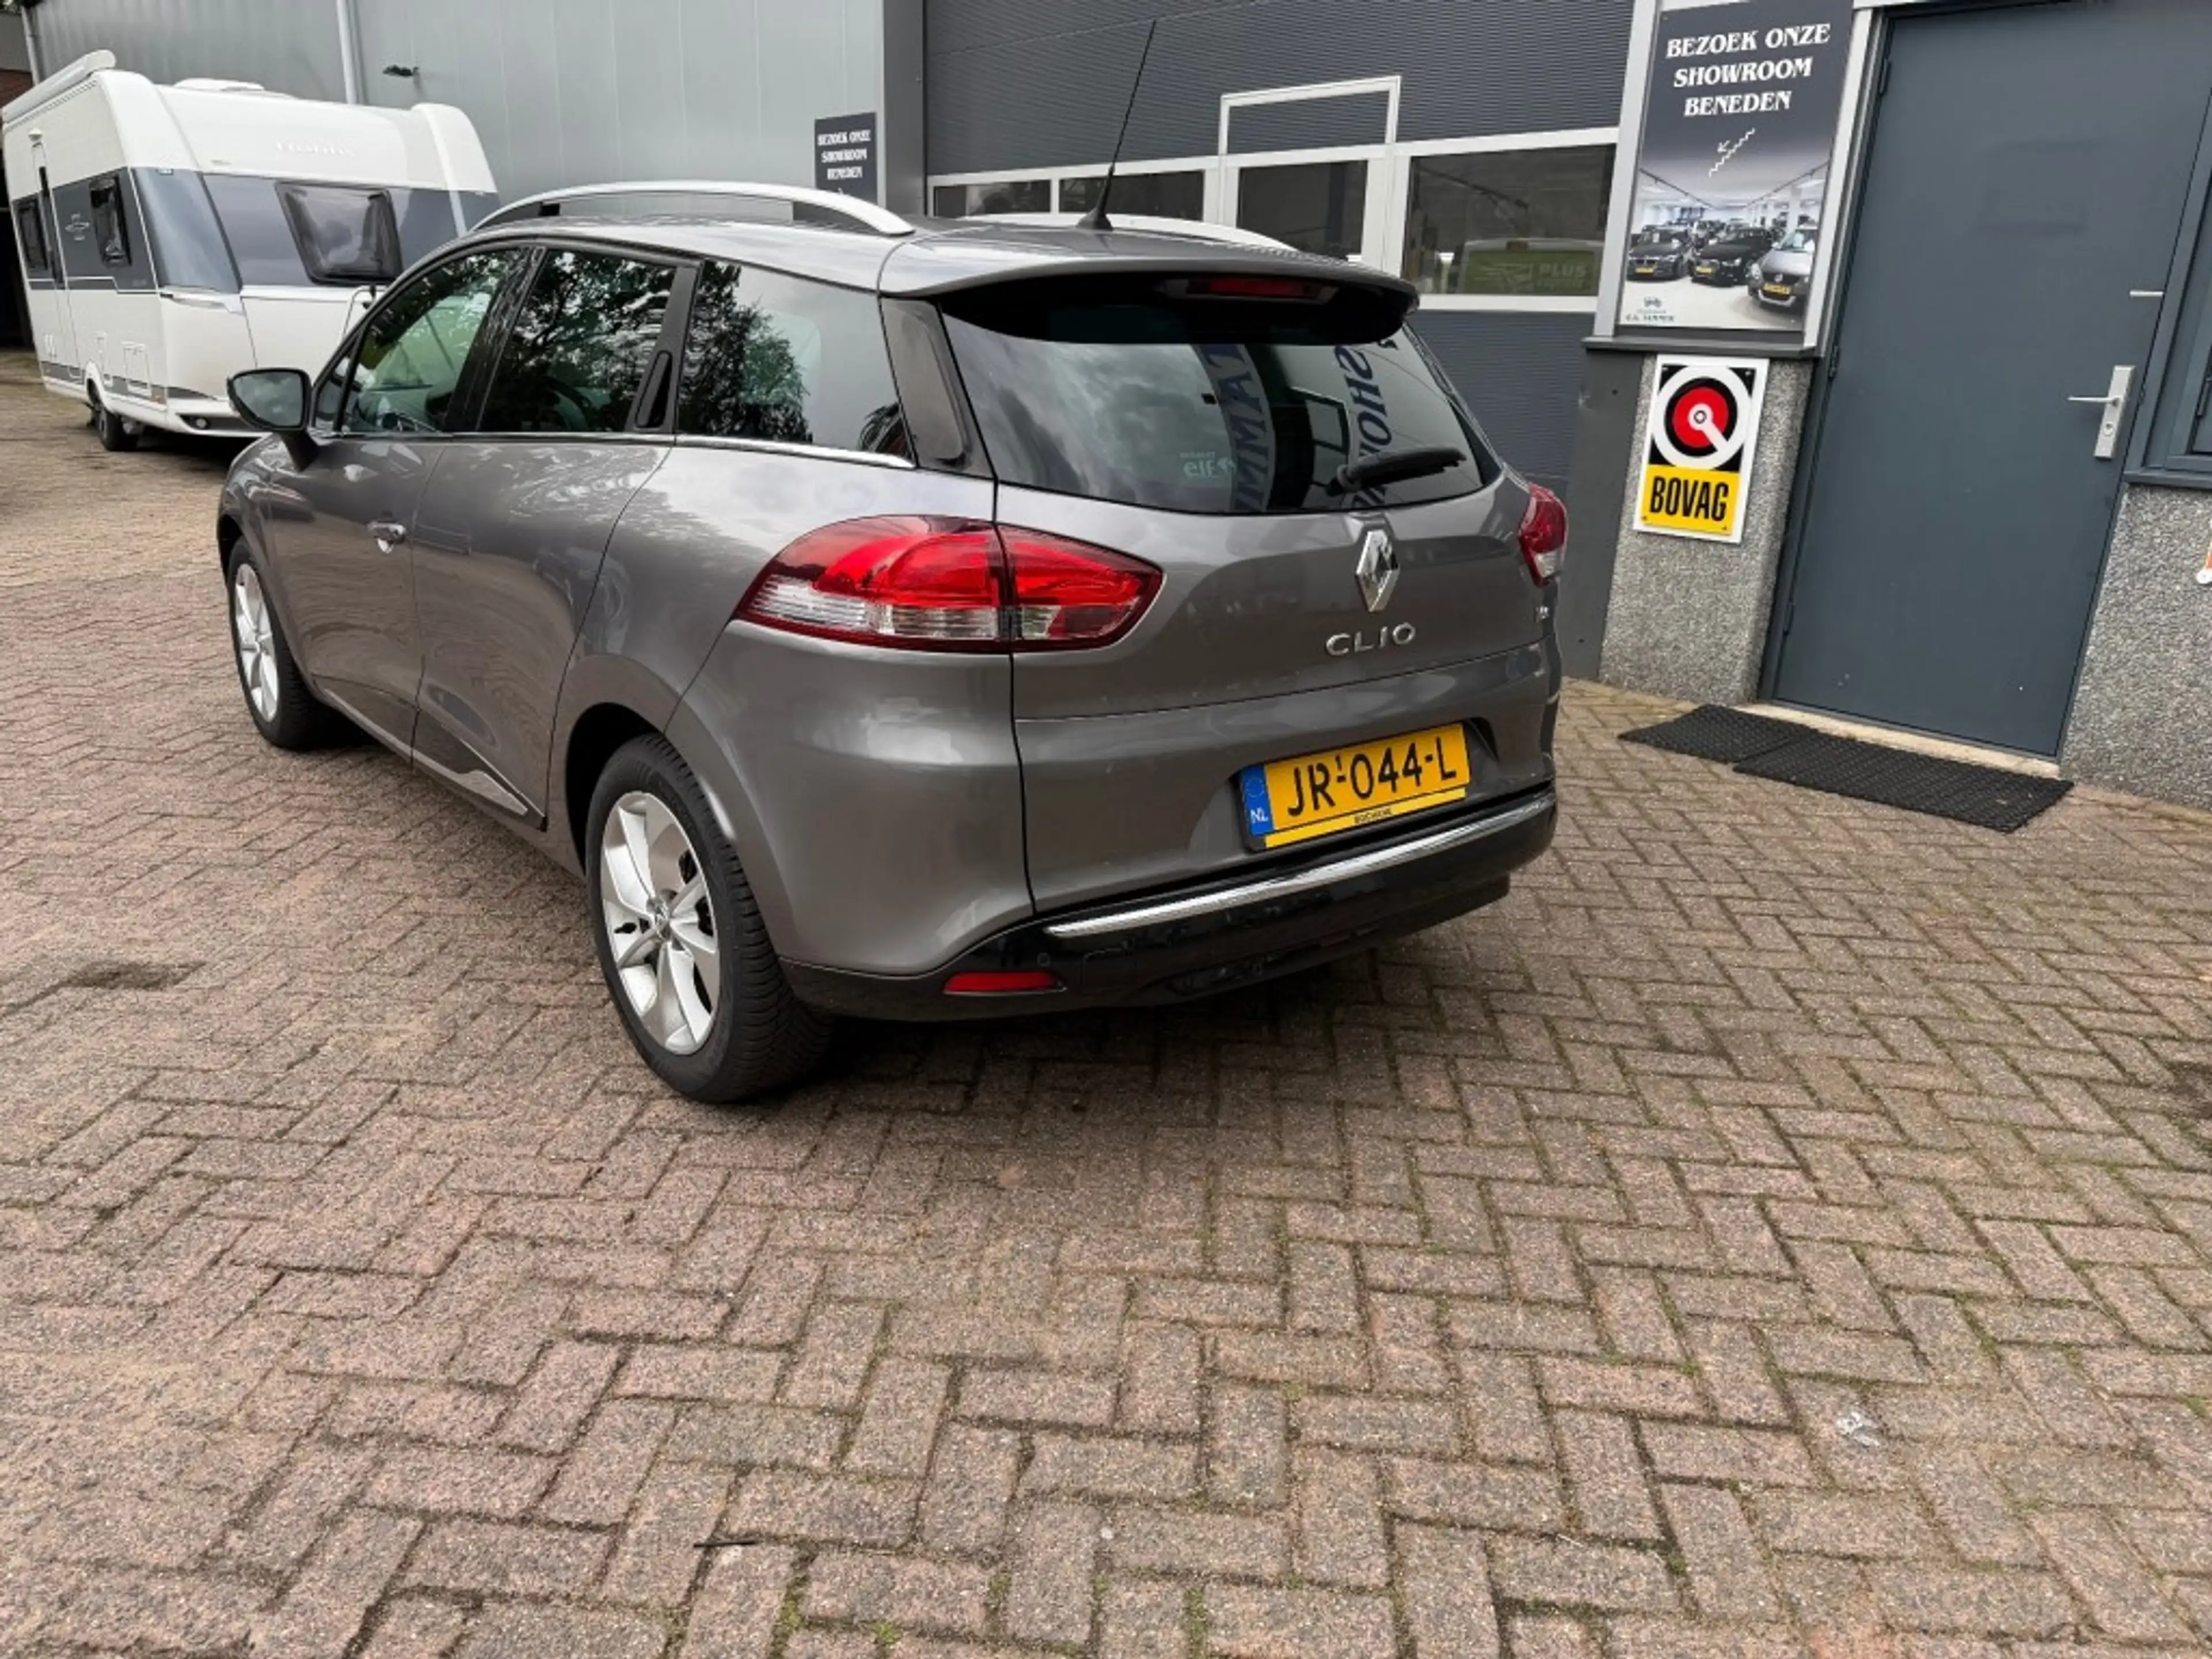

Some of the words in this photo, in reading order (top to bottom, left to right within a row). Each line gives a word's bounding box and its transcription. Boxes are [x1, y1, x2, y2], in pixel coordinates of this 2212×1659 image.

[1665, 31, 1759, 58] BEZOEK
[1765, 22, 1831, 48] ONZE
[1674, 57, 1813, 87] SHOWROOM
[1684, 90, 1792, 116] BENEDEN
[1650, 476, 1729, 522] BOVAG
[1326, 621, 1416, 656] CLIO
[1249, 807, 1268, 824] NL
